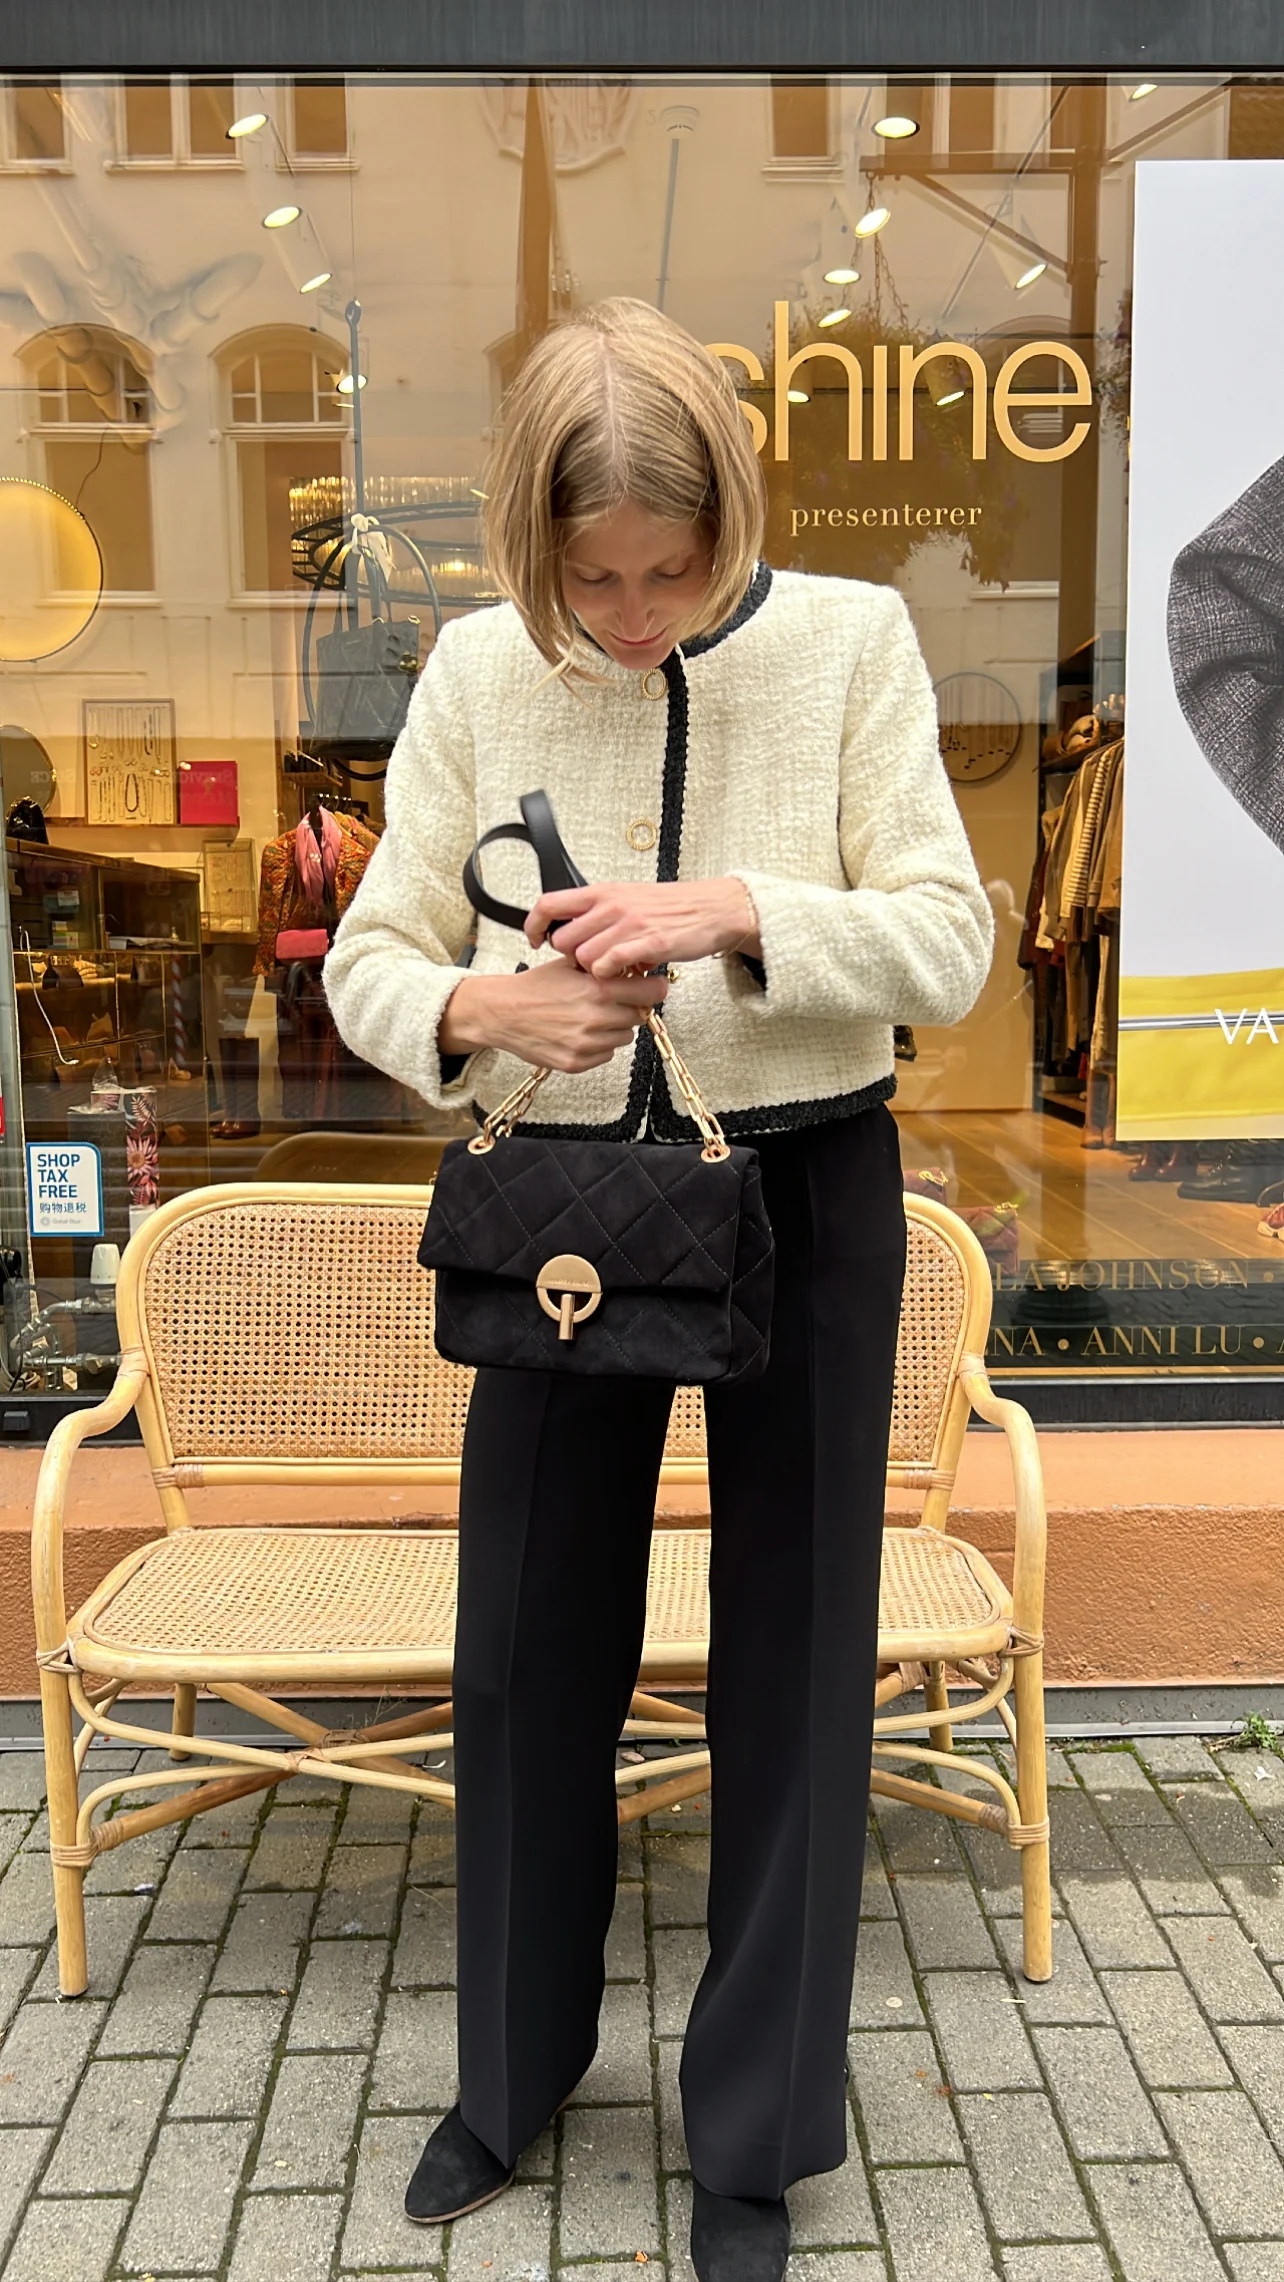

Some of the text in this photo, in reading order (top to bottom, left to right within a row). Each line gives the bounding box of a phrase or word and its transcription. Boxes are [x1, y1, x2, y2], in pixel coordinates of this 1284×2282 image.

[789, 503, 983, 536] presenterer
[1214, 1008, 1280, 1045] VA
[37, 1154, 80, 1167] SHOP
[38, 1169, 69, 1183] TAX
[38, 1184, 78, 1198] FREE
[995, 1260, 1249, 1291] LA JOHNSON
[984, 1327, 1046, 1356] NA
[1080, 1326, 1180, 1356] ANNI
[1191, 1326, 1244, 1355] LU
